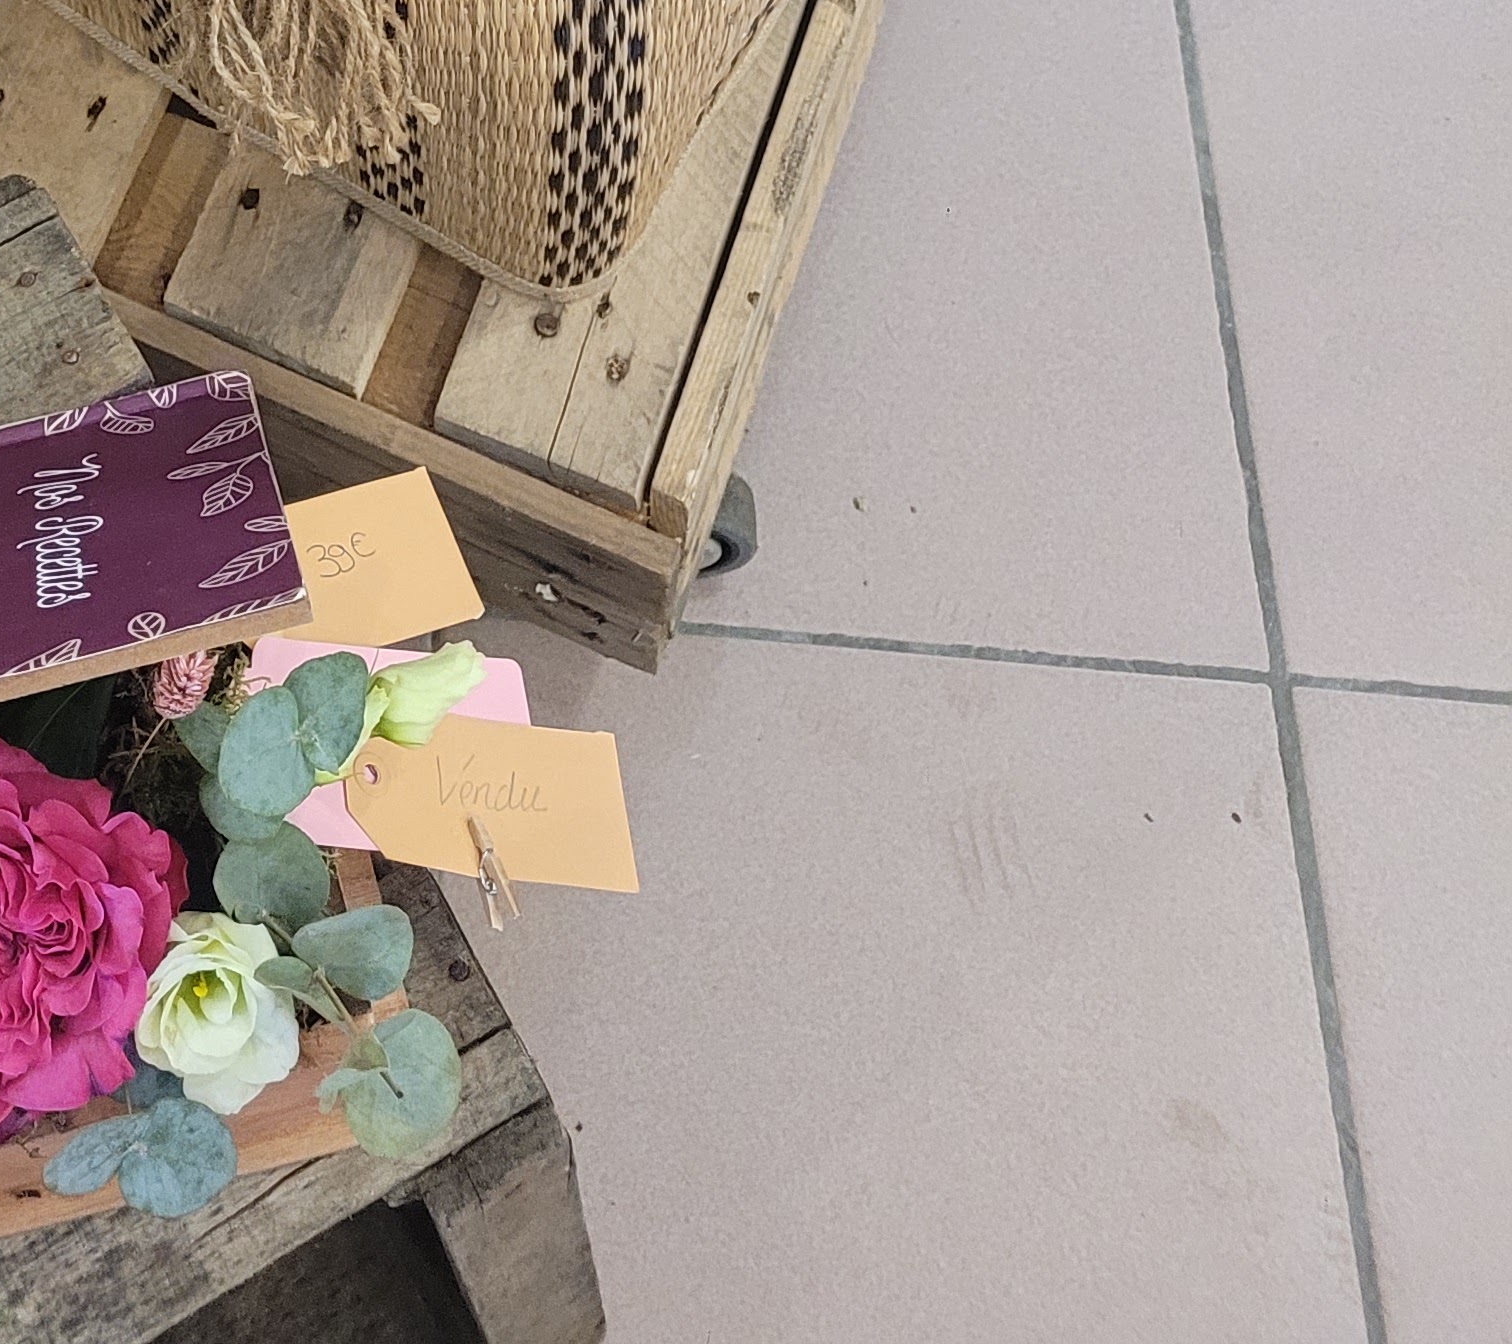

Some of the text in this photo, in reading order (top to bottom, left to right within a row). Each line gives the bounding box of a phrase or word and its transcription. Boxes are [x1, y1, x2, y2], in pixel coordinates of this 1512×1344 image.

[15, 452, 104, 609] Nos Recettes
[305, 531, 377, 579] 39€
[435, 753, 549, 812] Vendu
